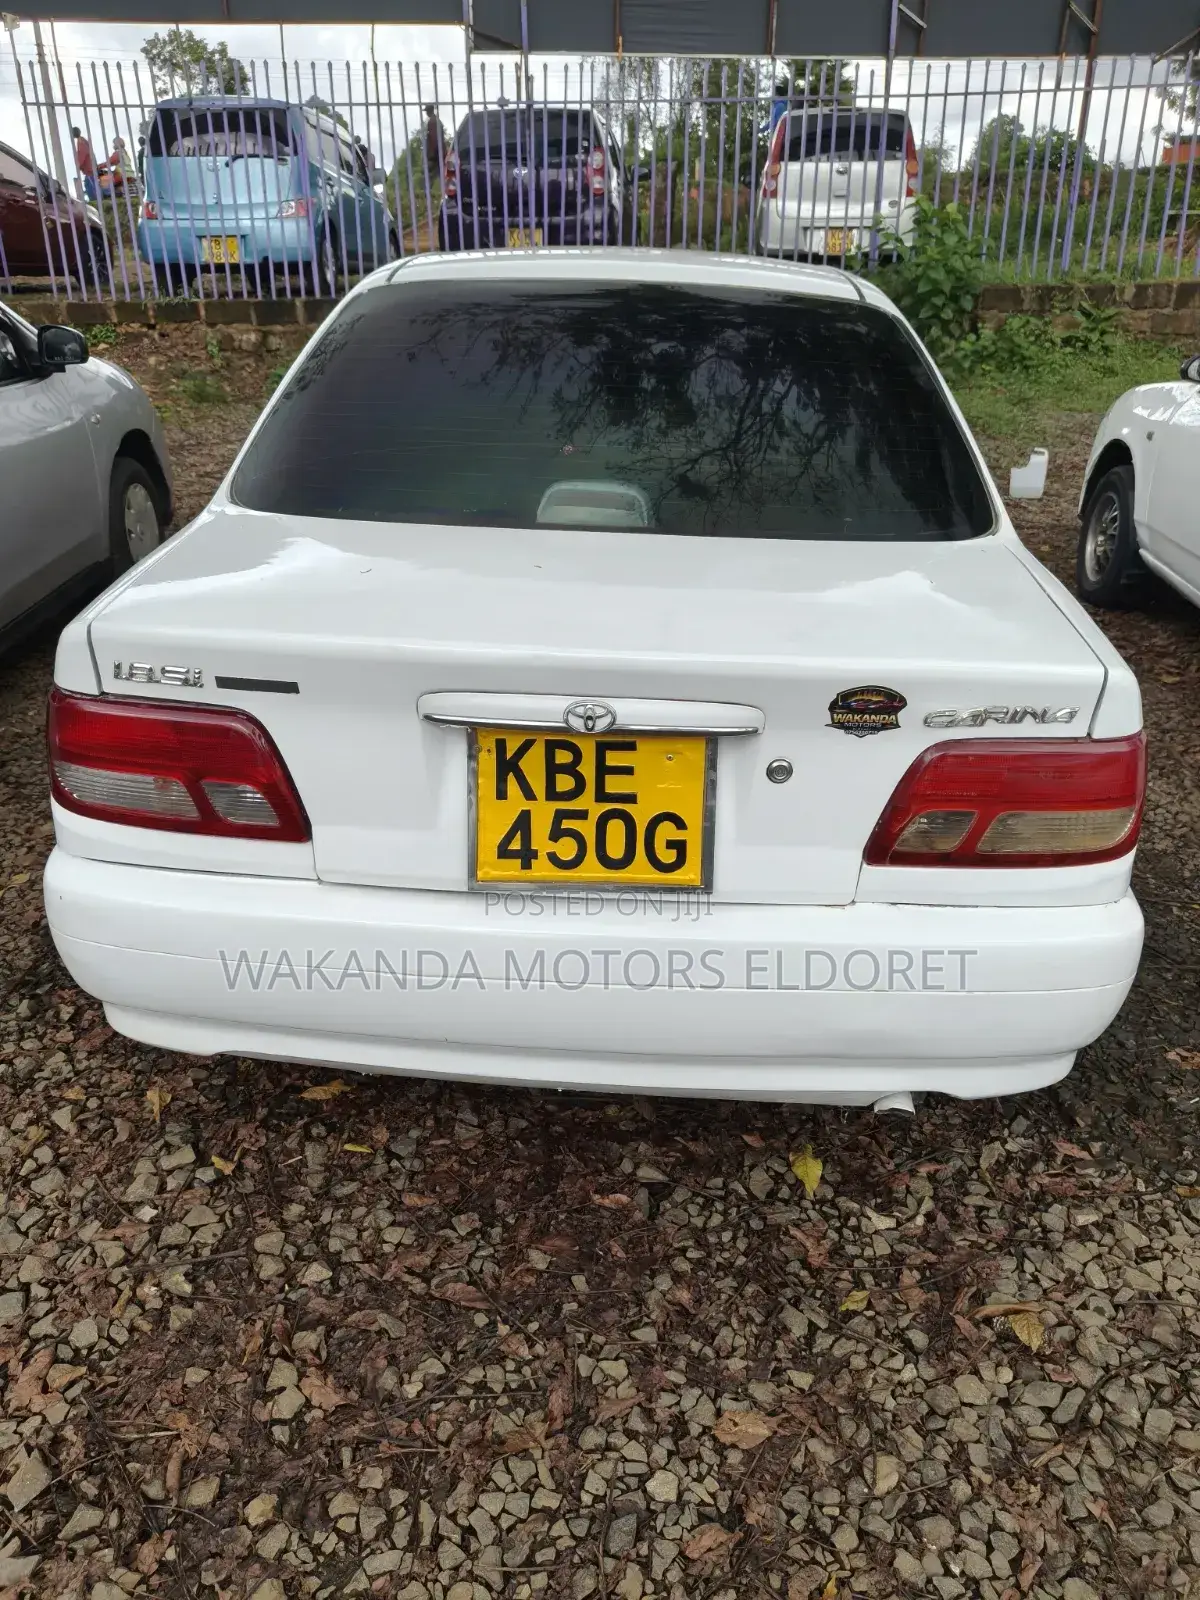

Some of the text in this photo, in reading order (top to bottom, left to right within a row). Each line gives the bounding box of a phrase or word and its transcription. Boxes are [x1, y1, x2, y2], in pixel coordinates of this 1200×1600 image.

[833, 713, 897, 724] WAKANDA
[923, 705, 1080, 728] CARINA
[494, 737, 638, 804] KBE
[496, 807, 688, 873] 450G
